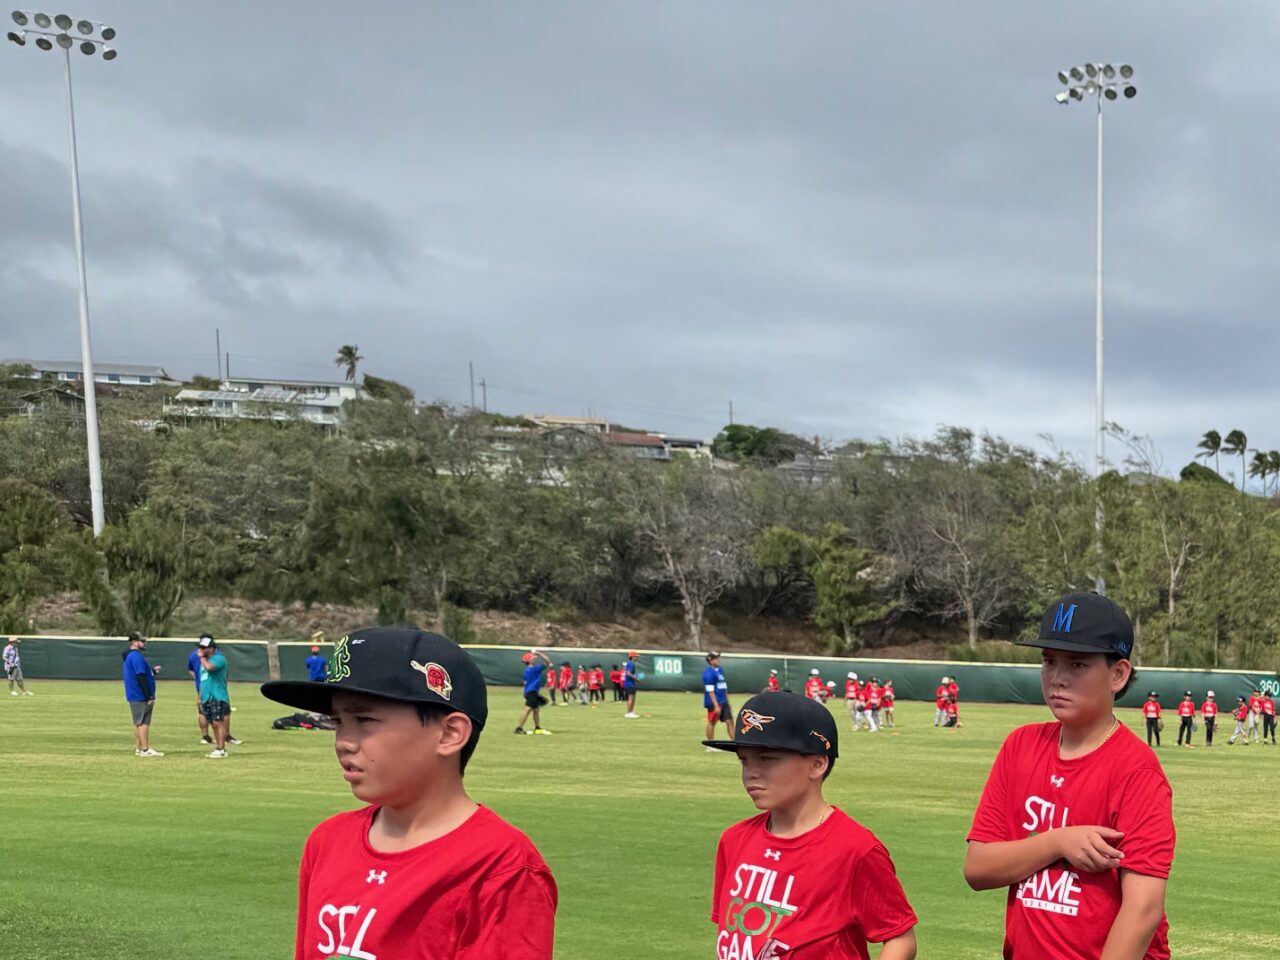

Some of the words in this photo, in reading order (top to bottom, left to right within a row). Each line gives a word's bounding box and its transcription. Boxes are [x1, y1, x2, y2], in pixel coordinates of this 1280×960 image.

[655, 659, 682, 674] 400
[730, 863, 799, 912] STILL
[1016, 867, 1082, 906] AME
[725, 897, 793, 938] GOT
